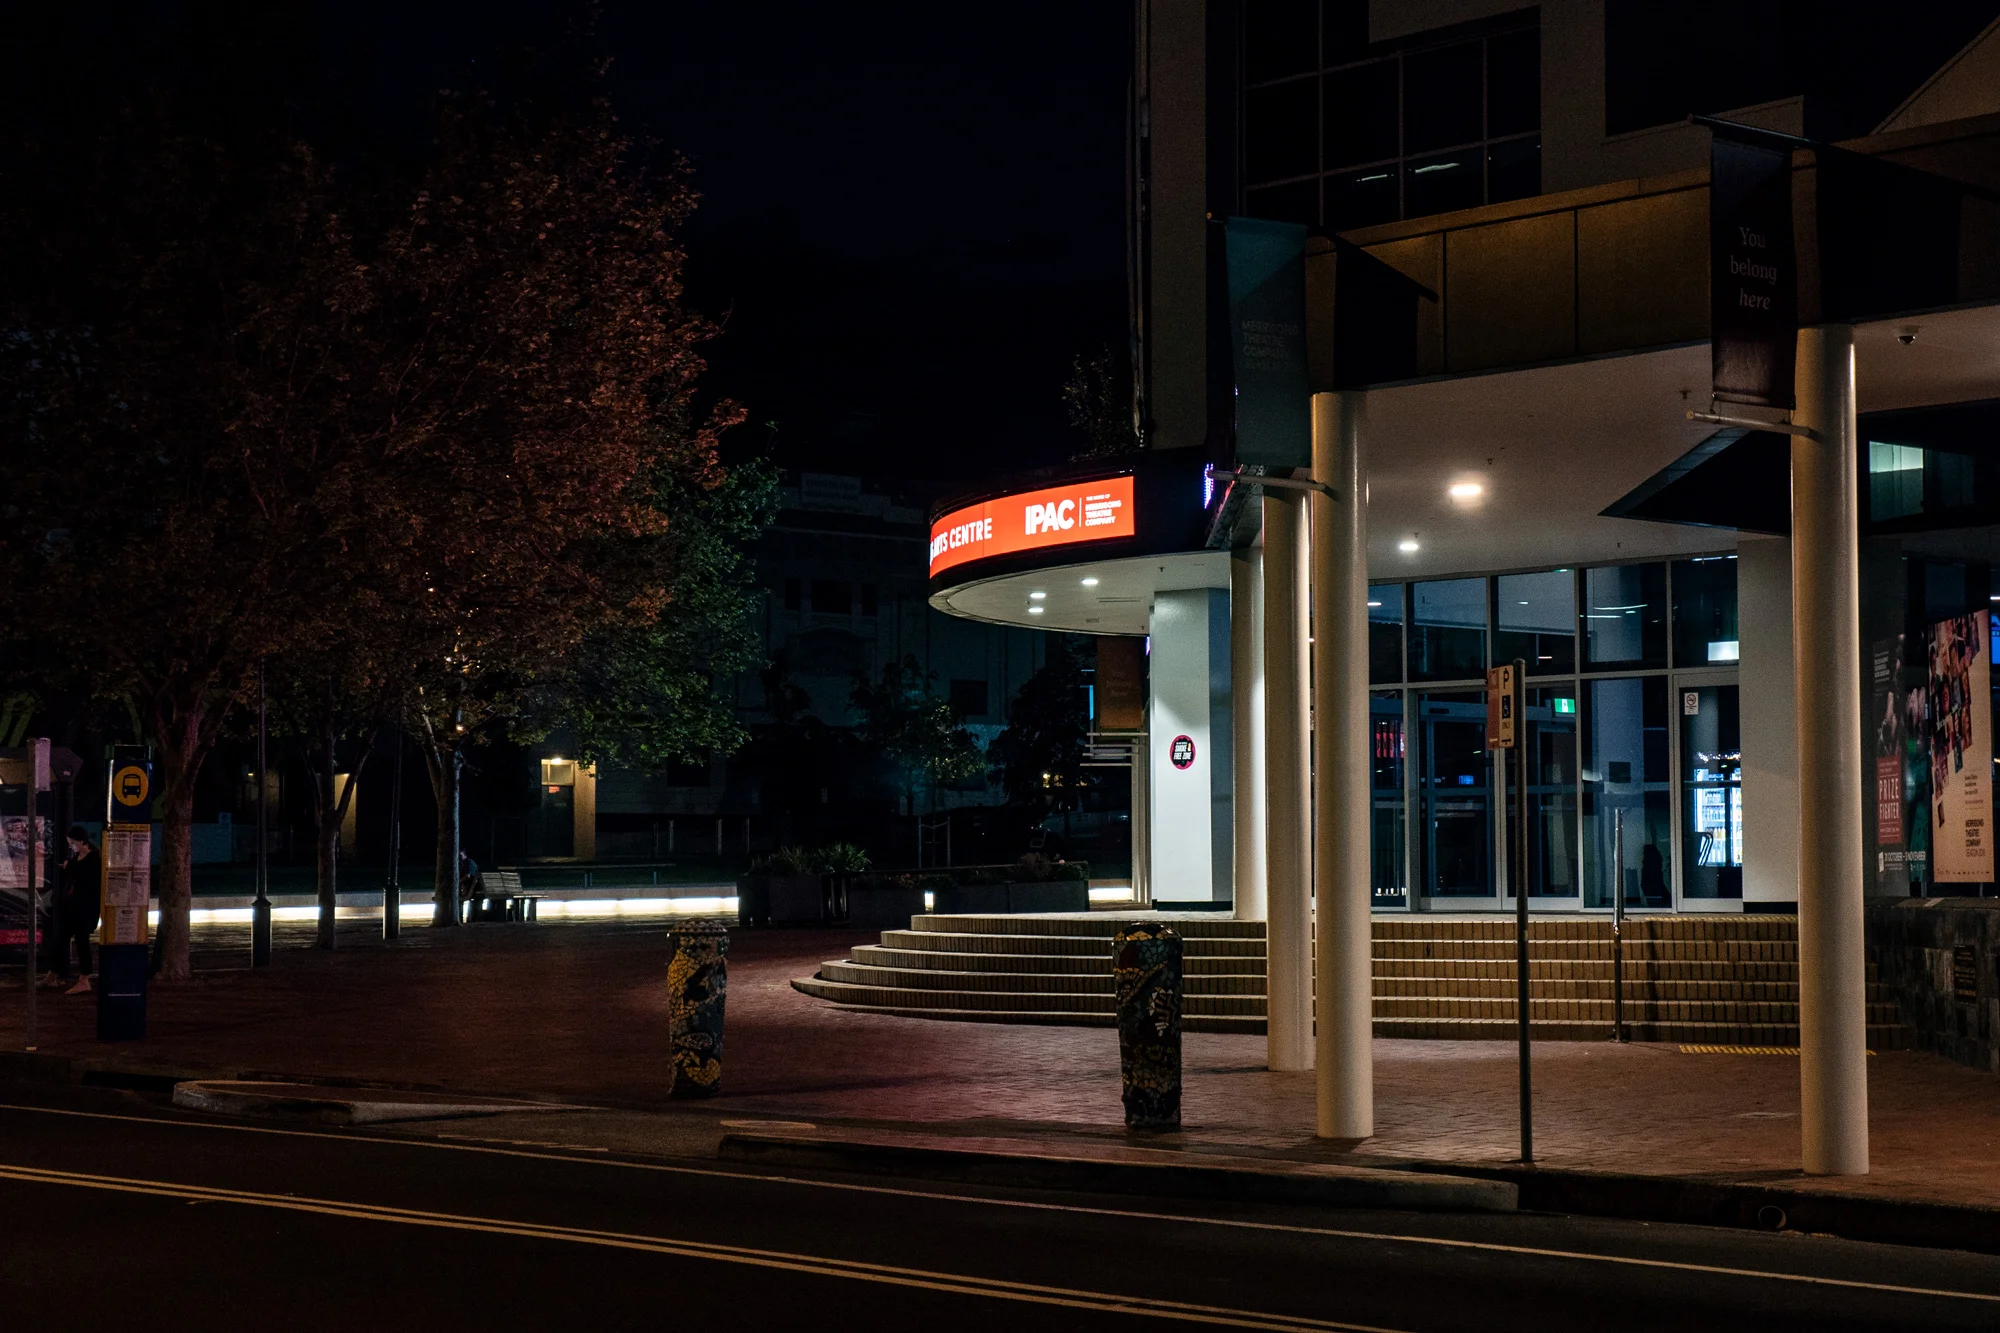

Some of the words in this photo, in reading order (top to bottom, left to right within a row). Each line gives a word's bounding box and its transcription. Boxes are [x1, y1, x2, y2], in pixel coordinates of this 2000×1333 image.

[1737, 225, 1767, 250] You
[1729, 253, 1777, 285] belong
[1739, 287, 1771, 311] here
[1025, 499, 1075, 535] IPAC
[949, 517, 992, 549] CENTRE
[1879, 778, 1899, 800] PRIZE
[1880, 802, 1900, 819] FIGHTER
